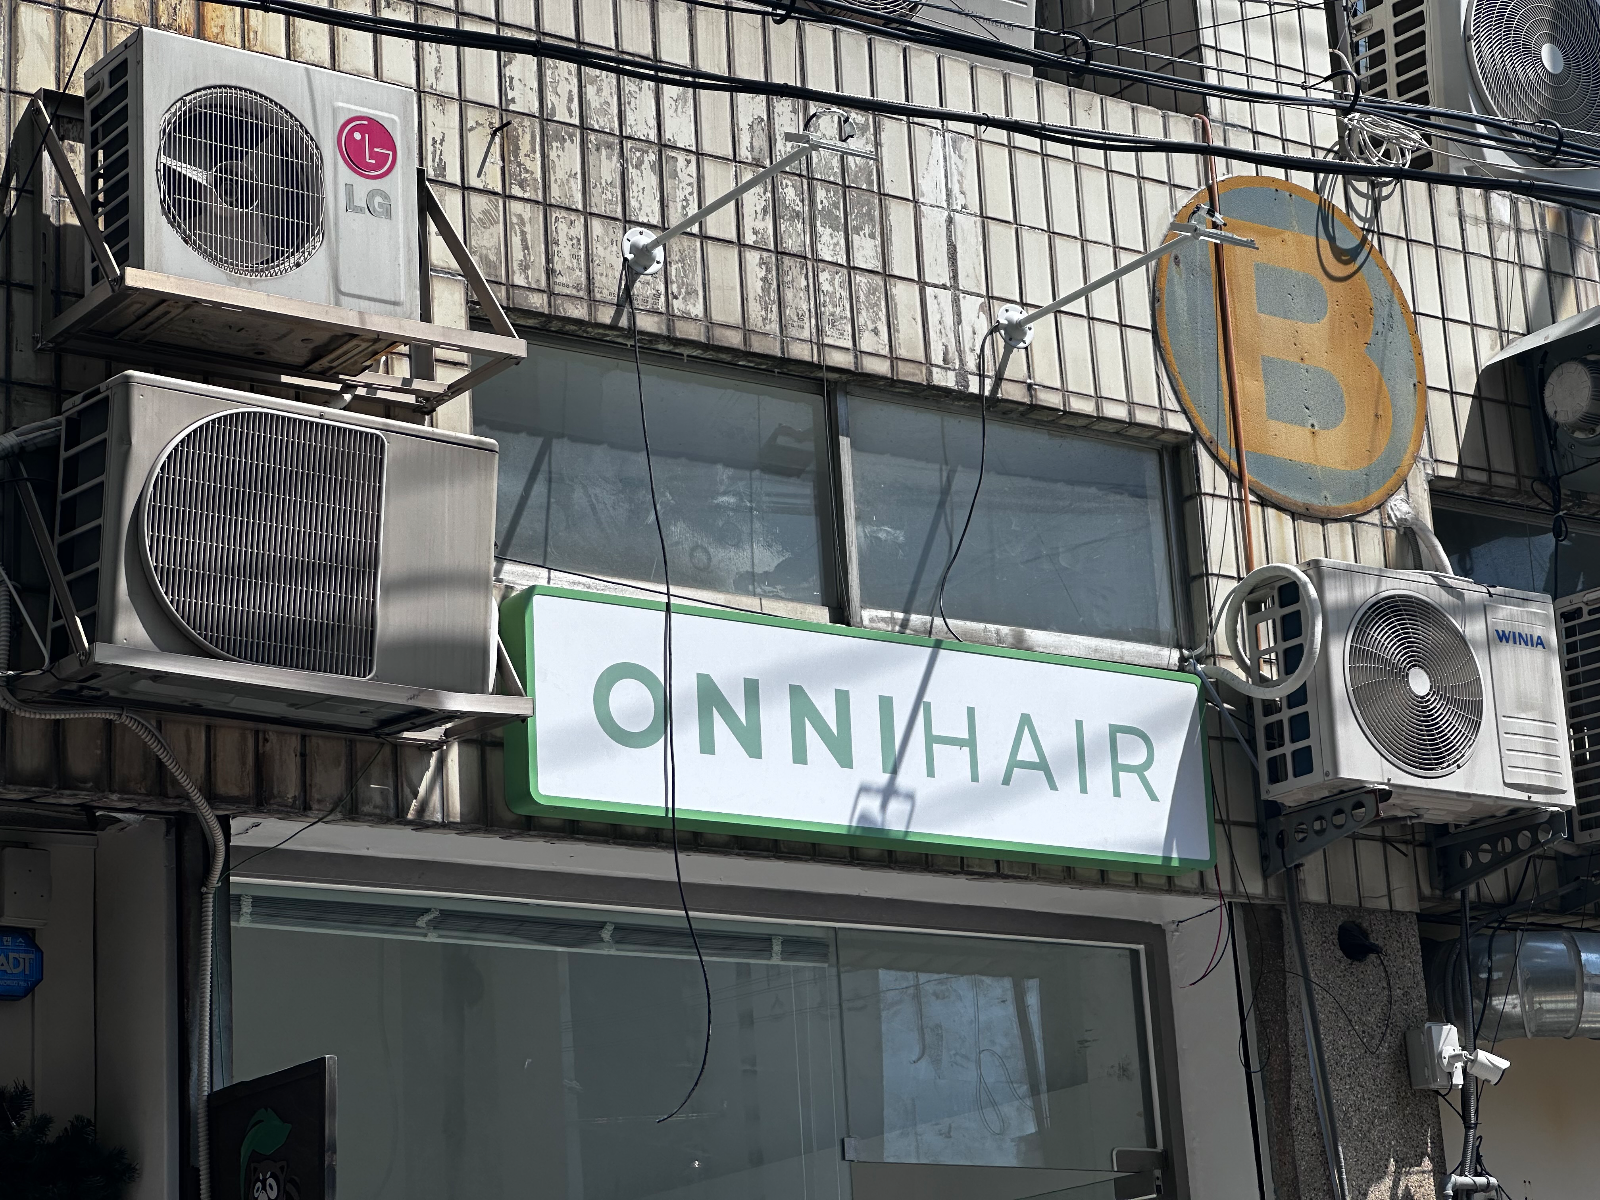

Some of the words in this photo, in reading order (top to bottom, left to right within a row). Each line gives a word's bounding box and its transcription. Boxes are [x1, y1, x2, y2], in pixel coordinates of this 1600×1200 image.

[342, 120, 392, 175] LG
[345, 183, 392, 220] LG
[1207, 214, 1392, 471] B
[1494, 629, 1547, 650] WINIA
[0, 952, 35, 975] ADT
